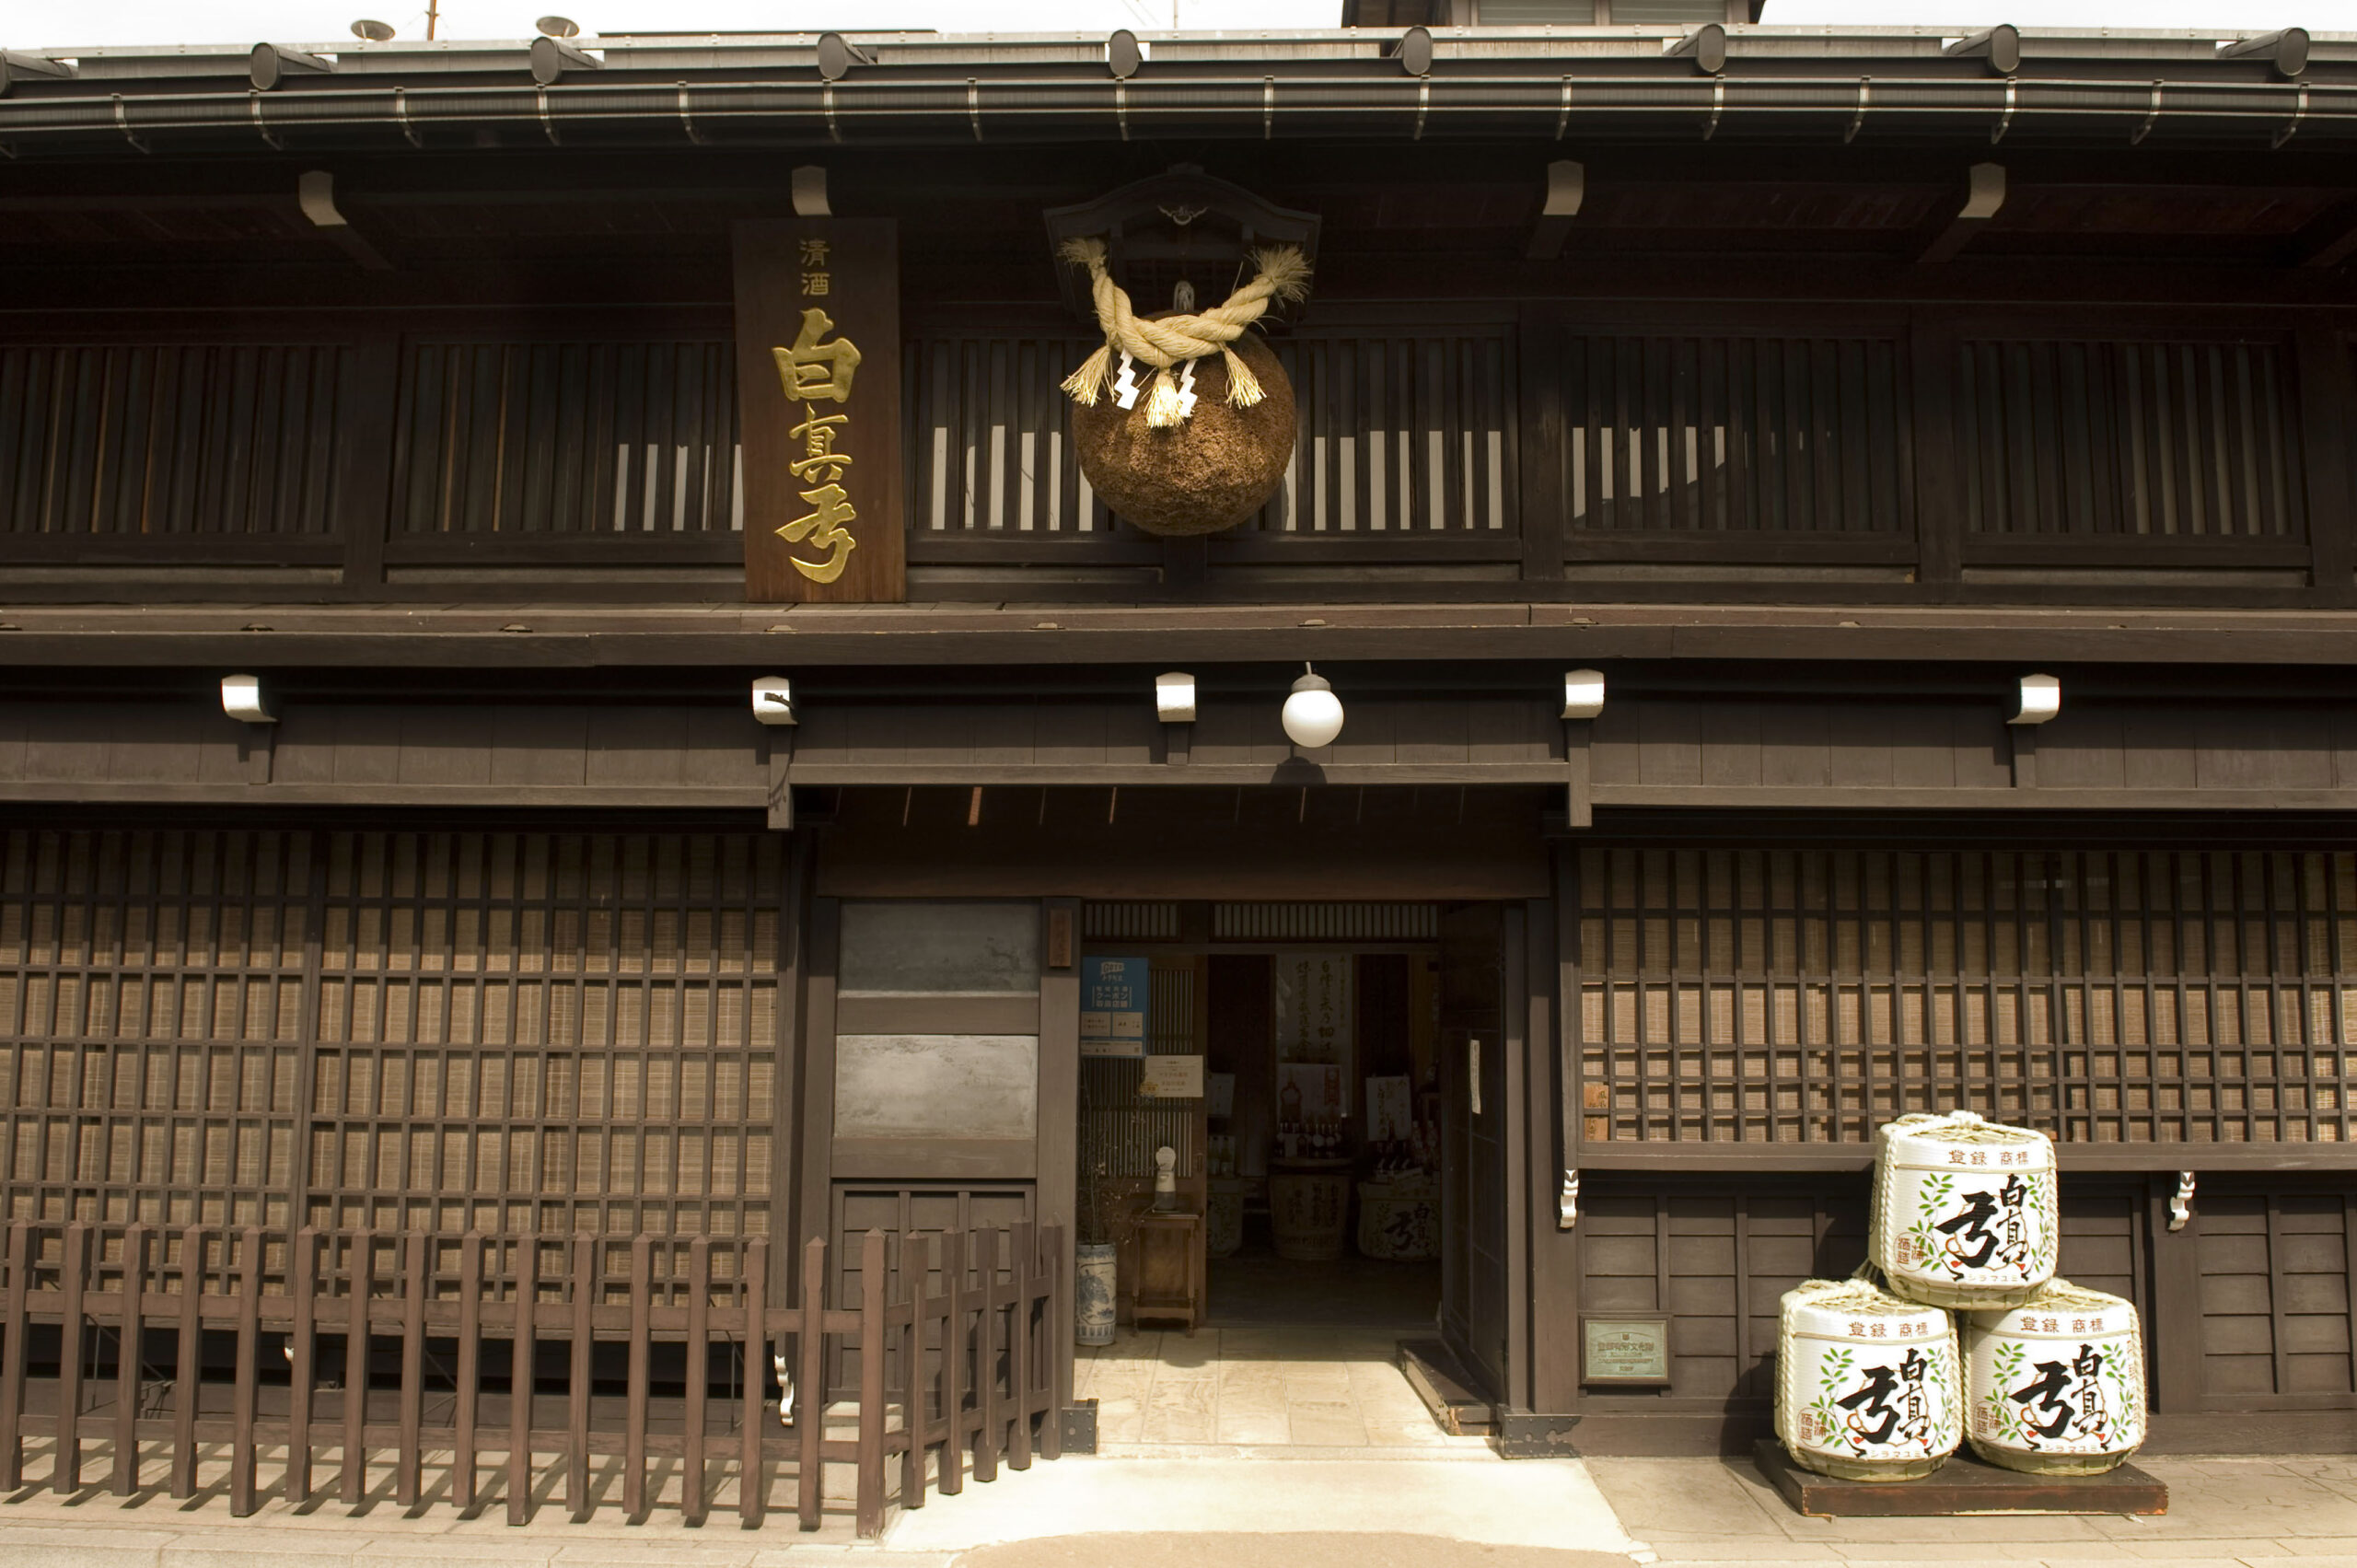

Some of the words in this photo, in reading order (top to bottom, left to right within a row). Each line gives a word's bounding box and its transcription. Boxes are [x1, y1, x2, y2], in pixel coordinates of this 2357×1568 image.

[799, 239, 830, 296] 清酒
[772, 307, 862, 584] 白真弓
[1947, 1149, 1988, 1166] 登録
[1999, 1150, 2029, 1166] 商標
[1968, 1274, 2019, 1283] シラマユミ
[1848, 1321, 1887, 1338] 登録
[1898, 1322, 1930, 1338] 商標
[2019, 1317, 2061, 1333] 登録
[2072, 1318, 2105, 1333] 商標
[1870, 1450, 1922, 1458] シラマユミ
